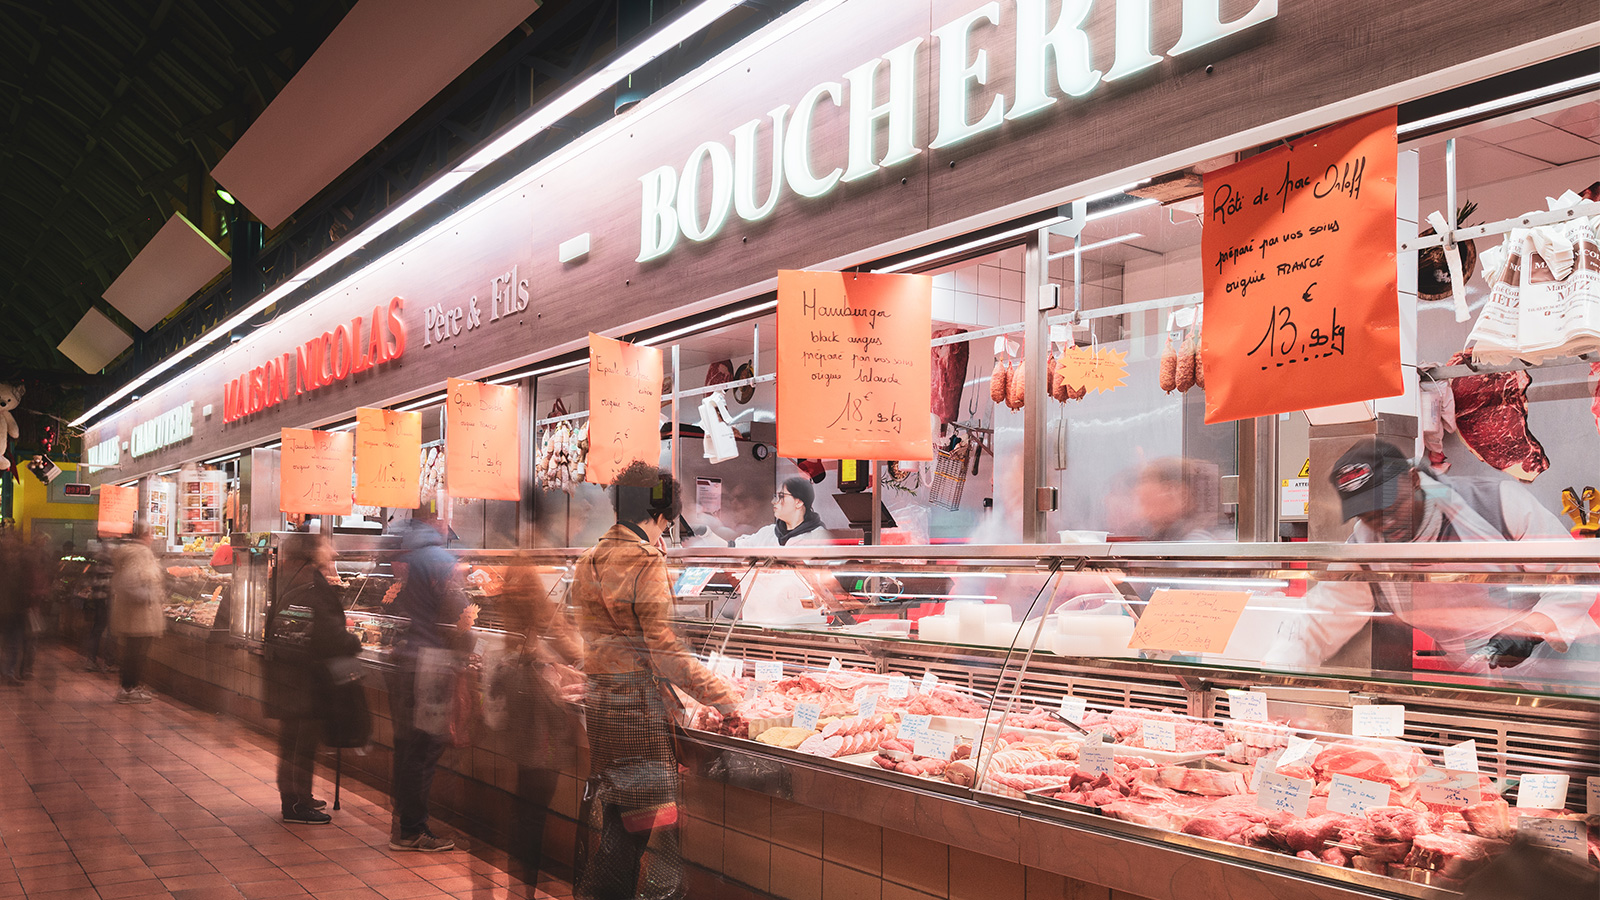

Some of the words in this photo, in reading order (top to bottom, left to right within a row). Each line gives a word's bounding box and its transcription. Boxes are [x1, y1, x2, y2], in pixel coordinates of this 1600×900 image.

[1213, 183, 1243, 224] Rôti
[1253, 186, 1270, 206] de
[1276, 161, 1312, 213] porc
[1215, 239, 1254, 275] préparé
[1259, 235, 1280, 259] par
[1225, 269, 1266, 297] origine
[1276, 254, 1326, 277] FRANCE
[802, 288, 892, 330] Hamburger
[222, 352, 290, 424] MAISON
[295, 296, 406, 395] NICOLAS
[423, 302, 462, 348] Père
[466, 295, 481, 330] &
[489, 264, 529, 322] Fils
[801, 349, 843, 367] préparé
[851, 353, 870, 369] par
[810, 331, 840, 343] black
[847, 335, 882, 352] angus
[811, 369, 842, 387] origine
